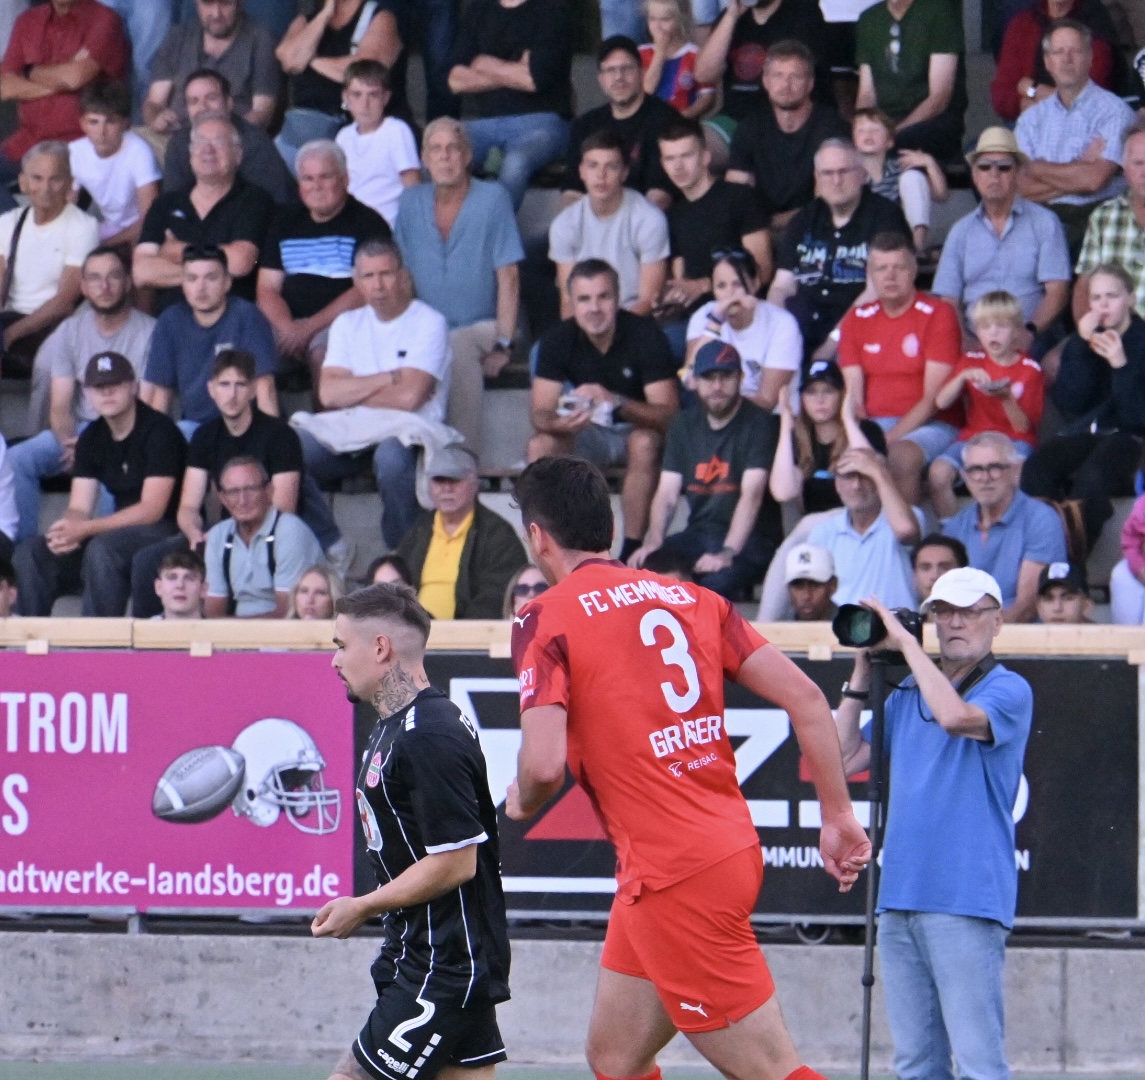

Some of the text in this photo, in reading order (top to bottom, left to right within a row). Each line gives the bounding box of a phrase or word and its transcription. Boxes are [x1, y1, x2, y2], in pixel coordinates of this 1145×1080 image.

[578, 590, 609, 616] FC
[639, 608, 701, 714] 3
[387, 998, 436, 1053] 2
[377, 1048, 410, 1072] capelli
